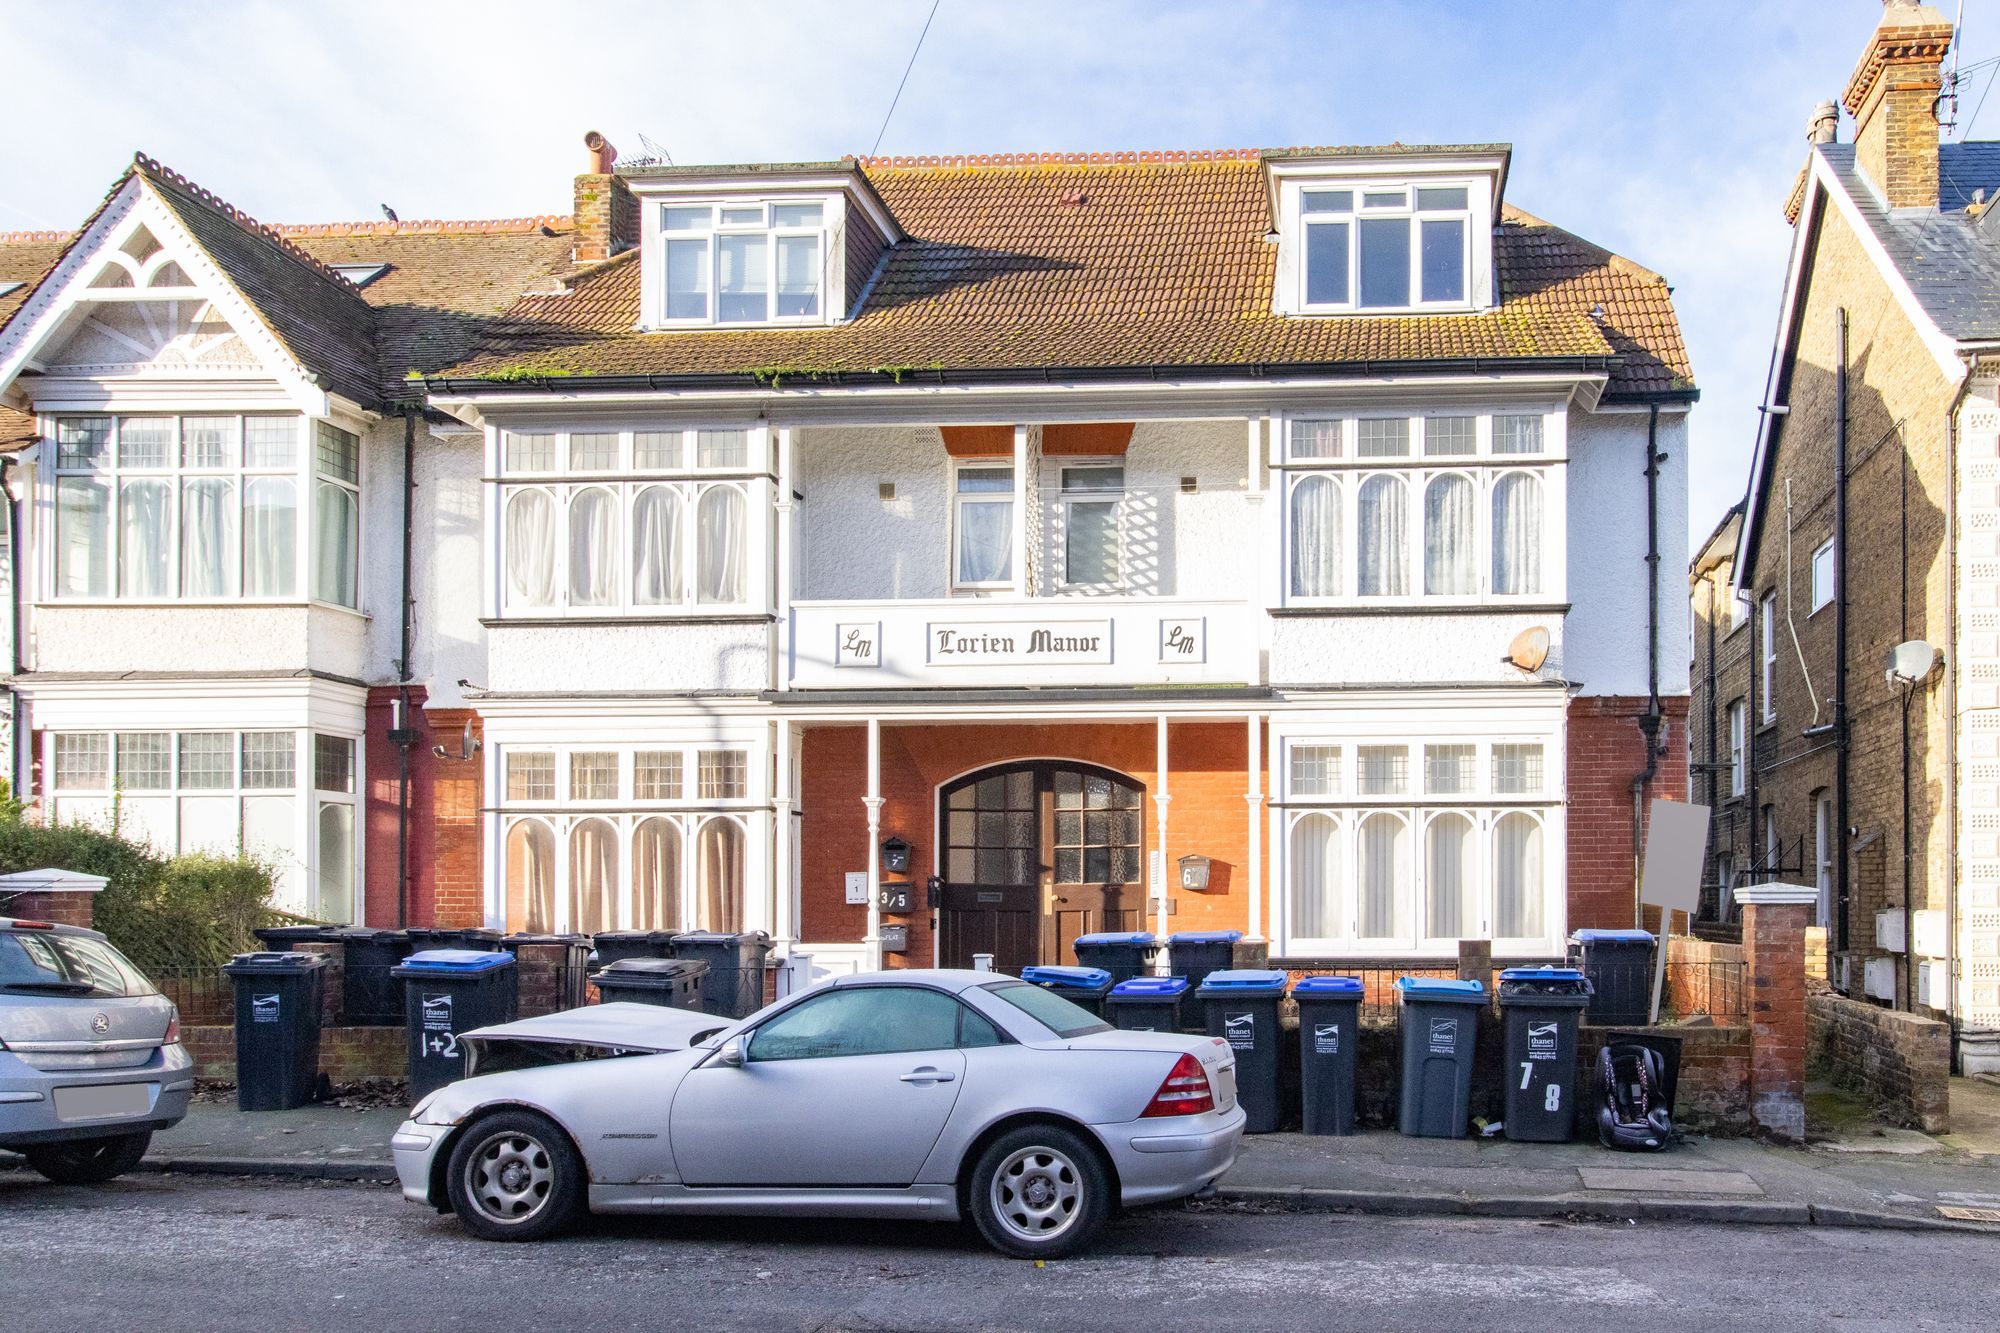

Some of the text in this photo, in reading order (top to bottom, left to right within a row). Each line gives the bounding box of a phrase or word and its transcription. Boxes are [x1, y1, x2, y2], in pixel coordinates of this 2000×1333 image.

[936, 629, 1100, 654] Lorien Manor
[1183, 868, 1191, 885] 6
[425, 1008, 449, 1016] thanet
[1432, 1032, 1453, 1040] thanet
[1531, 1037, 1554, 1045] thanet
[1520, 1062, 1533, 1090] 7
[1545, 1084, 1561, 1112] 8
